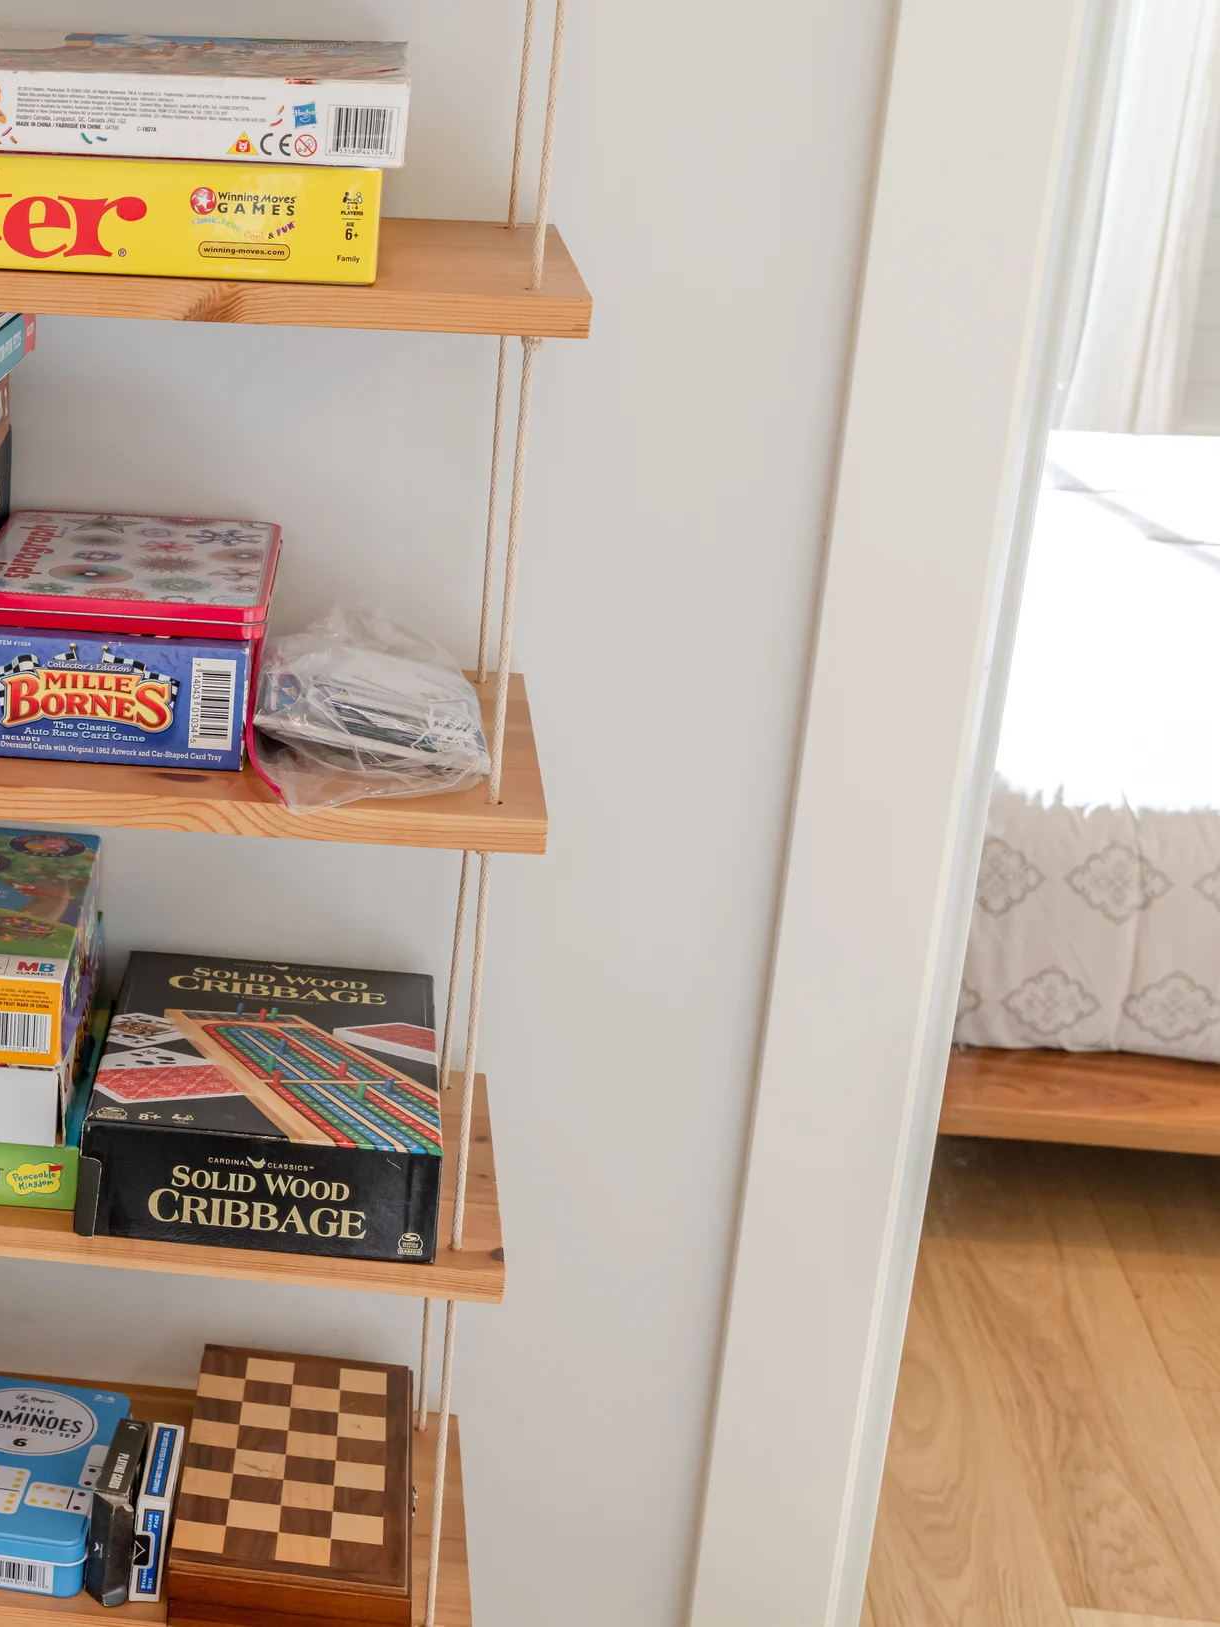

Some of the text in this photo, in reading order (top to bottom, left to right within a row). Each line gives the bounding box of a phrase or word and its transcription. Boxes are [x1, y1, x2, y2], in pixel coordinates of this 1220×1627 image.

[218, 191, 295, 204] Winning Moves
[218, 202, 295, 216] GAMES
[192, 216, 220, 226] Classic,
[221, 218, 243, 234] Retro,
[244, 231, 264, 241] Cool
[276, 222, 295, 236] FUN
[345, 228, 358, 240] 6+
[204, 246, 285, 256] winning-moves.com
[336, 255, 360, 263] Family
[4, 525, 62, 579] spirograph
[47, 660, 132, 672] Collector's Edition
[44, 672, 133, 694] MILLE
[6, 676, 173, 731] BORNES
[53, 721, 116, 732] The Classic
[24, 728, 145, 742] Auto Race Card Game
[0, 741, 32, 749] Oversized
[54, 744, 66, 752] with
[68, 746, 94, 754] Original
[112, 748, 137, 756] Artwork
[152, 751, 189, 760] Car-Shaped
[207, 754, 222, 762] Tray
[17, 962, 55, 972] MB
[193, 967, 368, 990] SOLID WOOD
[168, 976, 386, 1005] CRIBBAGE
[138, 1112, 162, 1120] 8+
[208, 1157, 308, 1172] CARDINAL CLASSICS
[11, 1171, 57, 1182] Peaceable
[18, 1180, 55, 1191] Kingdom
[171, 1166, 350, 1202] SOLID WOOD
[148, 1188, 367, 1240] CRIBBAGE
[32, 1428, 54, 1436] DOT
[59, 1432, 77, 1440] SET
[13, 1438, 28, 1447] 6
[108, 1452, 130, 1490] PLAYING CARDS
[146, 1578, 154, 1589] SIZE
